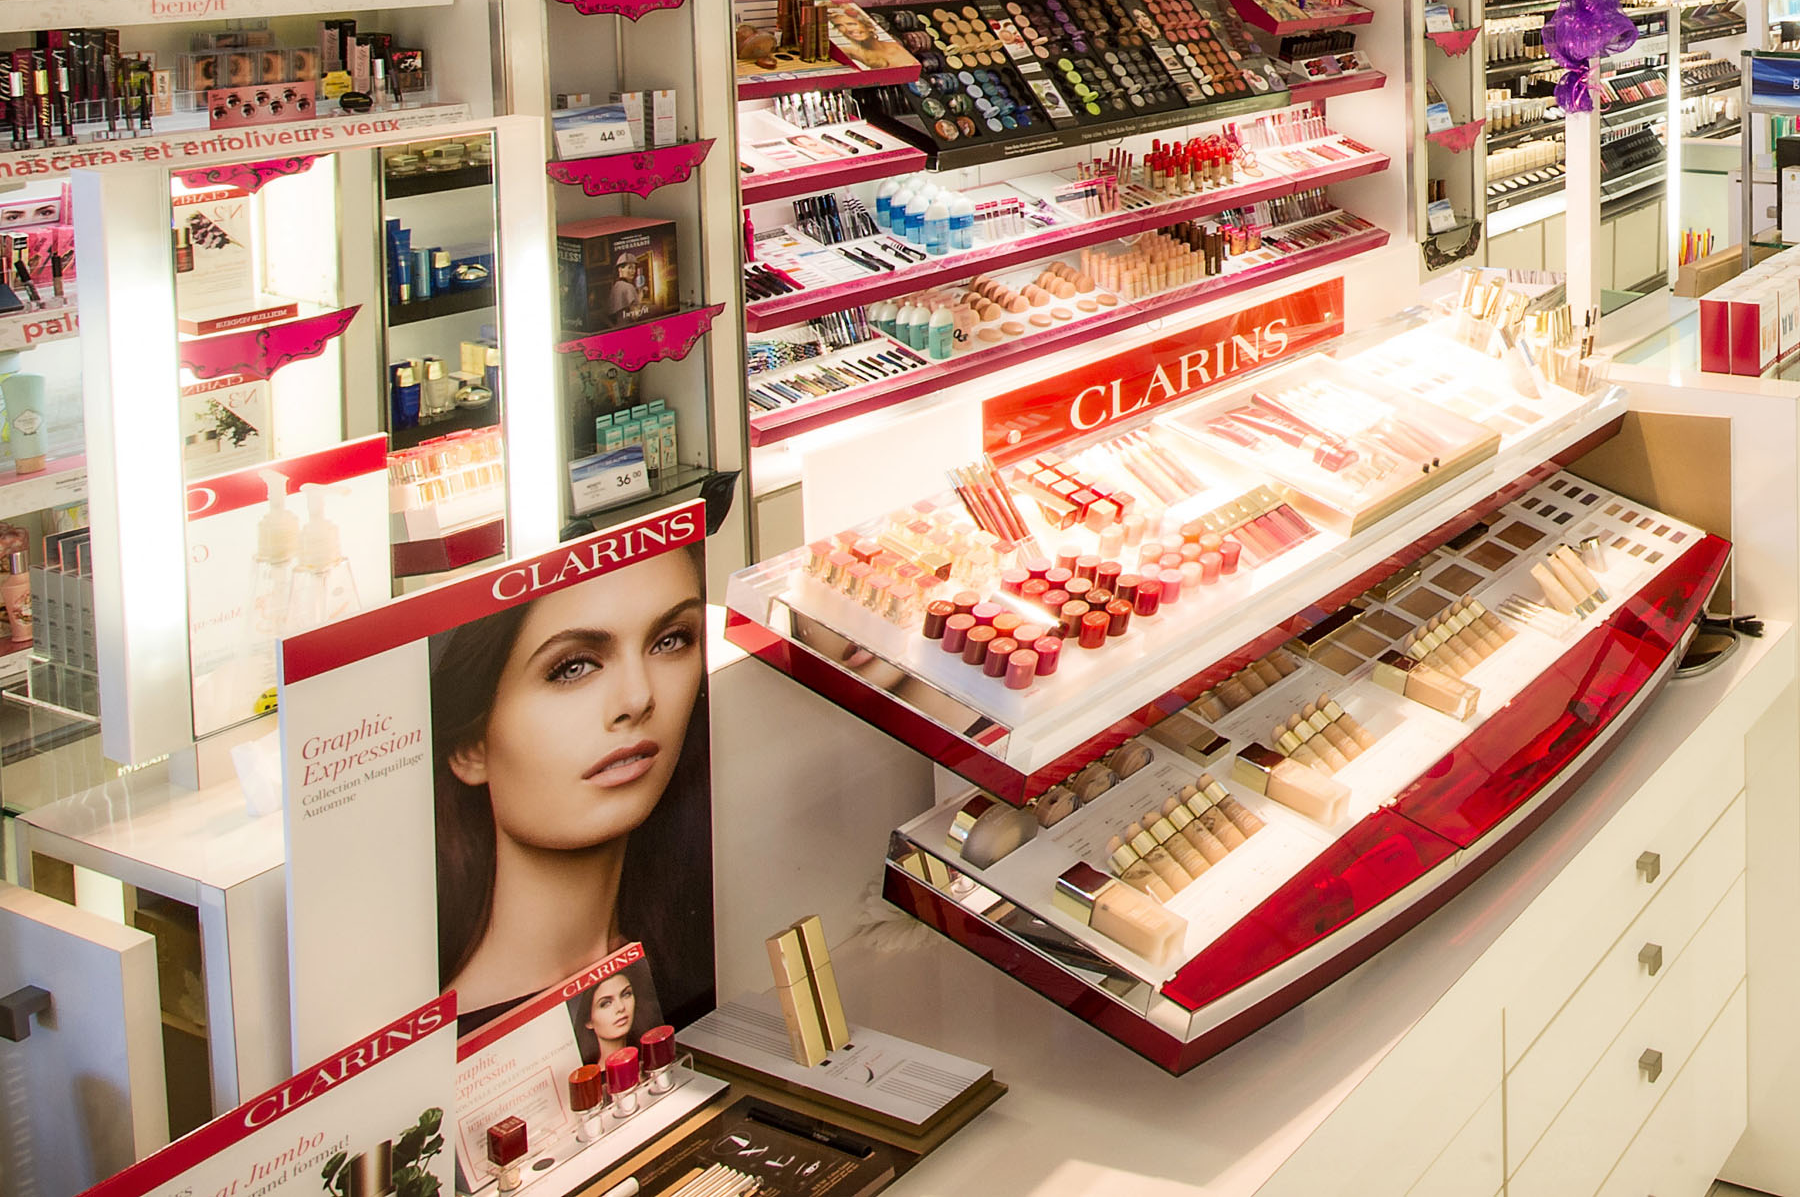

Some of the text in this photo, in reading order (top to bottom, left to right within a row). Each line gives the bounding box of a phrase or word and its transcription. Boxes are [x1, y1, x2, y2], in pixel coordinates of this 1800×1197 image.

[144, 141, 174, 161] et
[600, 130, 615, 142] 44
[23, 311, 81, 343] pal
[1070, 317, 1290, 432] CLARINS
[616, 473, 631, 487] 36
[491, 511, 698, 603] CLARINS
[302, 713, 393, 761] Graphic
[302, 729, 421, 787] Expression
[302, 752, 424, 807] Collection Maquillage
[302, 793, 357, 821] Automne
[562, 945, 641, 998] CLARINS
[244, 1005, 443, 1129] CLARINS
[455, 1052, 498, 1086] raphic
[244, 1130, 326, 1189] Jumbo
[292, 1134, 350, 1179] format!
